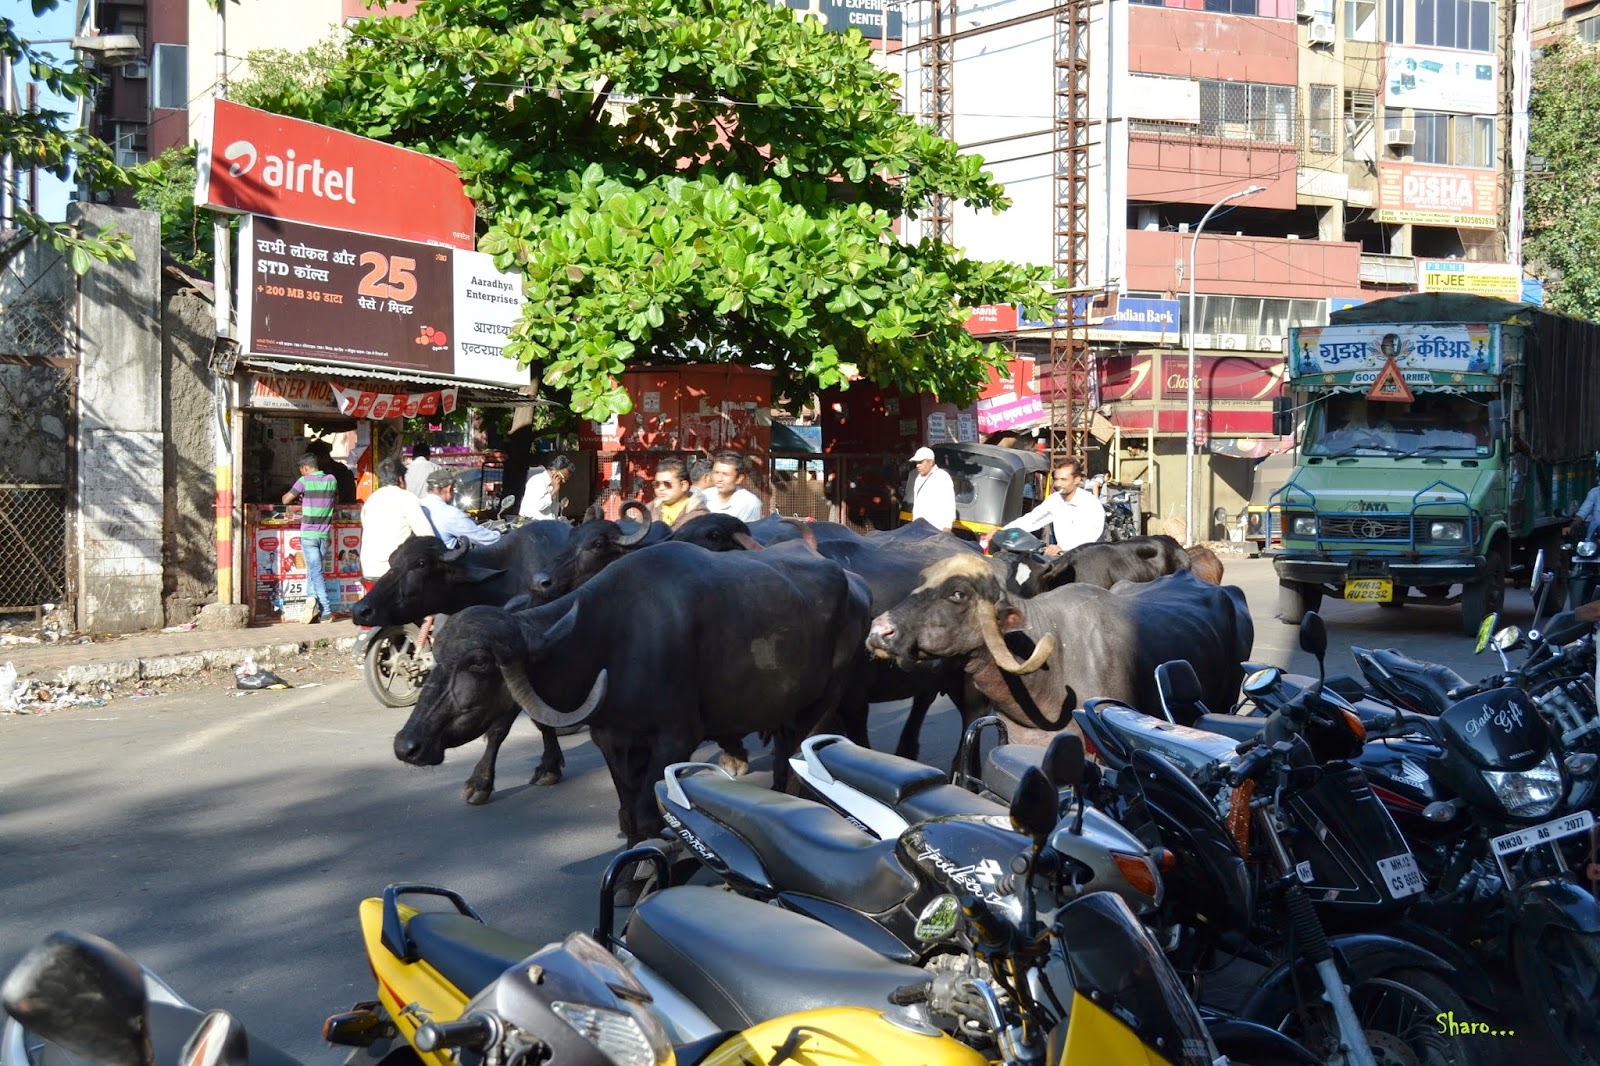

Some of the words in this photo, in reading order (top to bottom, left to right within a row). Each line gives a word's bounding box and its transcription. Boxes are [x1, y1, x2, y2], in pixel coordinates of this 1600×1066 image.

[845, 0, 903, 12] EXPERINC
[848, 12, 887, 26] CENTE
[263, 149, 356, 204] airtel
[257, 238, 287, 256] सभी
[290, 243, 328, 262] लोकल
[332, 249, 357, 266] और
[257, 259, 289, 276] STD
[293, 264, 330, 282] कॉल्स
[1426, 262, 1464, 272] PRIME
[357, 251, 418, 302] 25
[470, 276, 514, 291] Aaradhya
[1427, 273, 1465, 286] IIT-JEE
[265, 285, 285, 297] 200
[286, 287, 305, 299] MB
[306, 289, 321, 301] 3G
[323, 293, 344, 304] डाटा
[466, 289, 519, 305] Enterprises
[357, 296, 377, 310] पैसे
[387, 300, 414, 315] मिनट
[1146, 309, 1174, 323] Bank
[1167, 374, 1202, 389] Clasic
[1355, 373, 1378, 382] GOO
[1402, 373, 1431, 382] ARRIER
[255, 376, 306, 399] MASTER
[1360, 503, 1389, 512] TATA
[289, 584, 302, 594] 25
[1465, 703, 1495, 738] Dad's
[1493, 700, 1523, 733] Gift
[1390, 774, 1424, 790] HONDA
[1497, 835, 1523, 851] MH30
[1537, 827, 1550, 840] AG
[1563, 816, 1585, 831] 2077
[1391, 876, 1404, 891] CS
